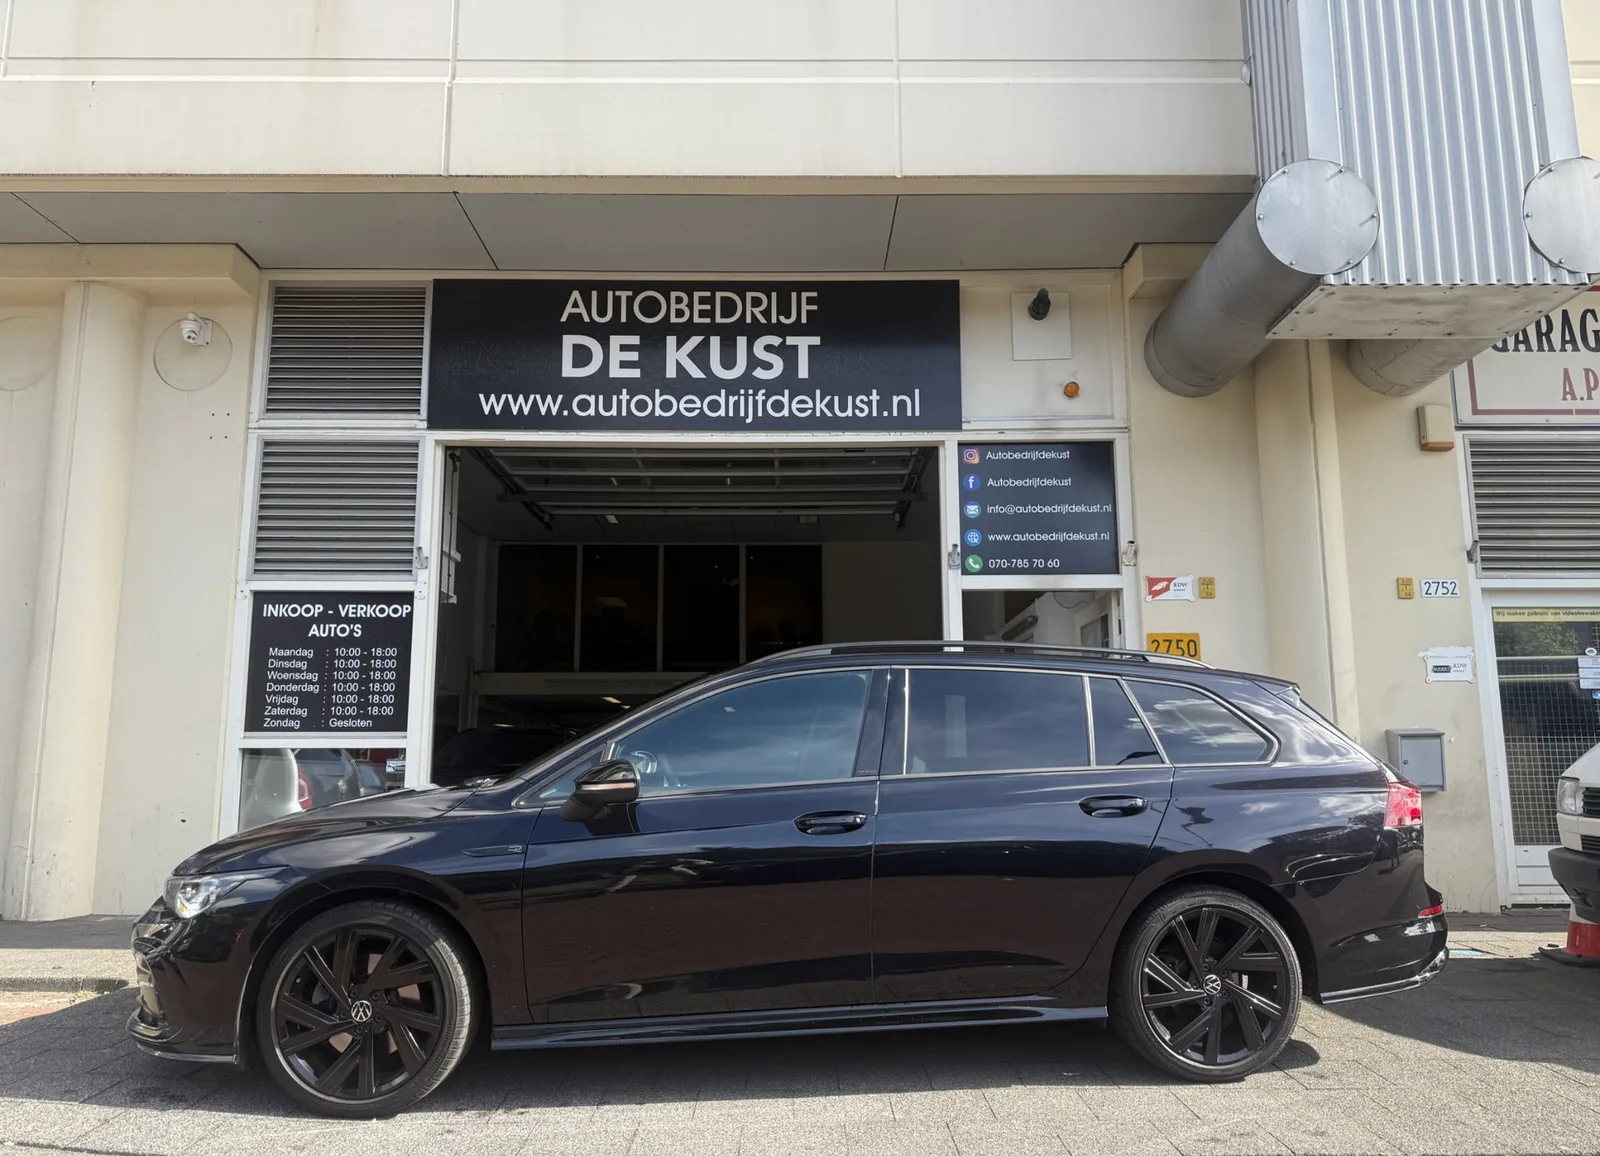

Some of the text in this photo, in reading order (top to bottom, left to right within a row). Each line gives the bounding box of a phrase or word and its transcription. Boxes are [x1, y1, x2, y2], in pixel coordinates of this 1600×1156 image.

[560, 290, 818, 324] AUTOBEDRIJF
[561, 335, 821, 379] DE KUST
[478, 388, 920, 424] www.autobedrijfdekust.nl
[985, 450, 1070, 461] Autobedrijfdekust
[986, 477, 1072, 488] Autobedrijfdekust
[987, 503, 1112, 515] info@autobedrijfdekust.nl
[987, 531, 1110, 543] www.autobedrijfdekust.nl
[988, 558, 1060, 569] 070-785 70 60
[1423, 580, 1458, 596] 2752
[262, 603, 324, 617] INKOOP
[338, 604, 412, 618] VERKOOP
[307, 623, 362, 638] AUTO'S
[269, 647, 314, 659] Maandag
[334, 647, 361, 657] 10:00
[370, 647, 398, 657] 18:00
[1151, 638, 1198, 658] 2750
[268, 659, 308, 670] Dinsdag
[333, 659, 360, 669] 10:00
[370, 659, 397, 669] 18:00
[267, 671, 319, 682] Woensdag
[333, 671, 360, 680] 10:00
[369, 671, 396, 680] 18:00
[266, 682, 320, 694] Donderdag
[332, 682, 359, 692] 10:00
[368, 682, 396, 692] 18:00
[265, 694, 299, 706] Vrijdag
[331, 694, 358, 704] 10:00
[368, 694, 395, 704] 18:00
[264, 706, 308, 717] Zaterdag
[330, 706, 358, 716] 10:00
[367, 706, 394, 716] 18:00
[263, 717, 301, 729] Zondag
[328, 717, 373, 728] Gesloten
